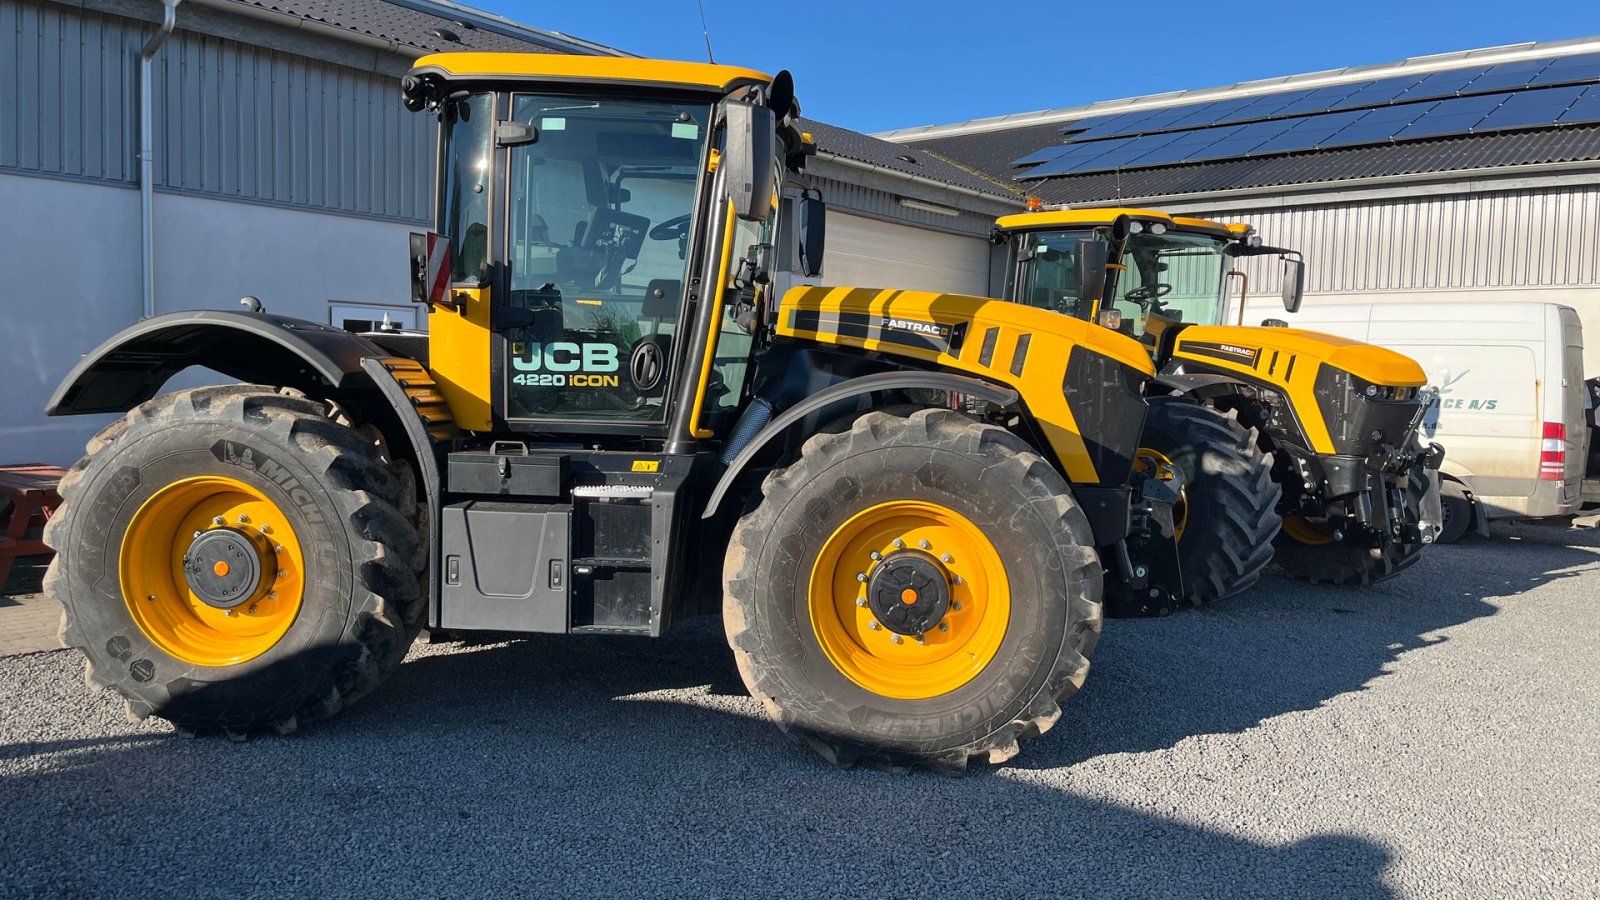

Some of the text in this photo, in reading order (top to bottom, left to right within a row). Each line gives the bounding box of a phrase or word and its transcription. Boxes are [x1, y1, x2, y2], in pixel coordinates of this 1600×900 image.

[881, 318, 940, 334] FASTRAC
[513, 342, 619, 371] JCB
[513, 374, 619, 387] 4220 iCON
[1468, 399, 1498, 410] A/S
